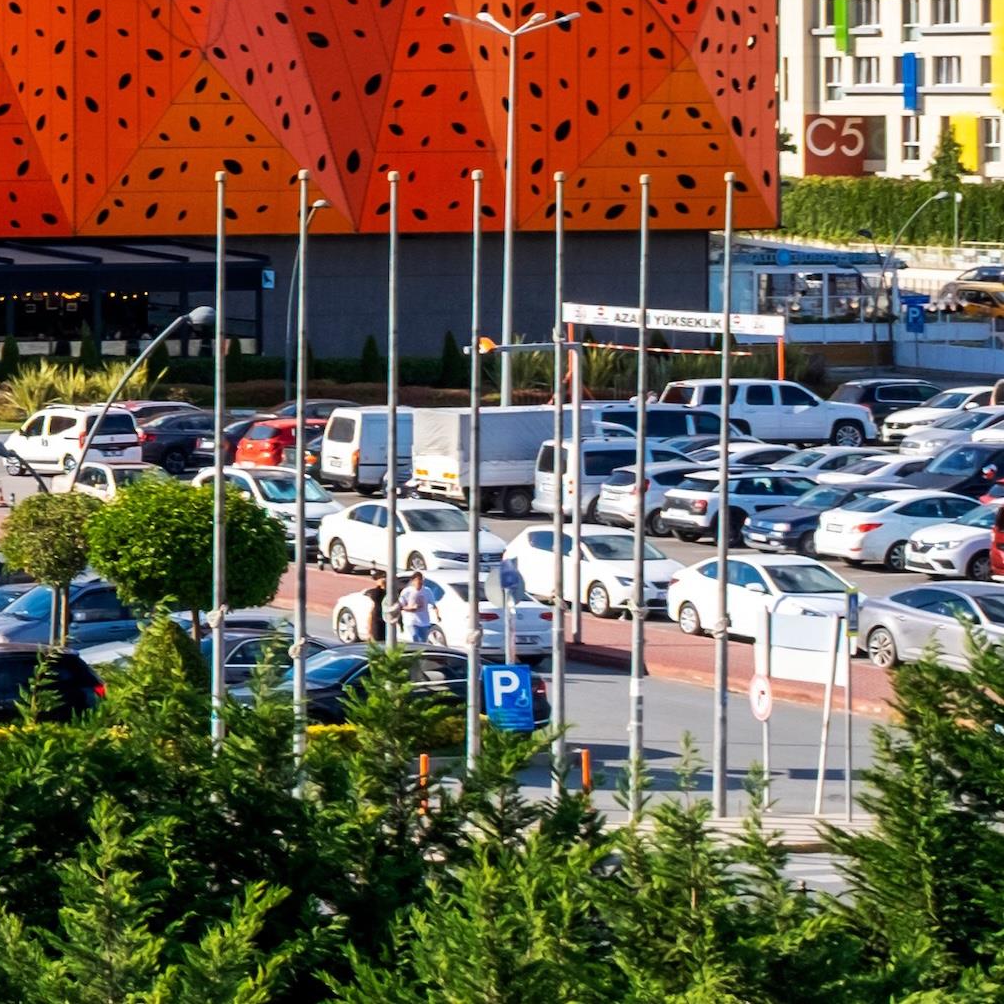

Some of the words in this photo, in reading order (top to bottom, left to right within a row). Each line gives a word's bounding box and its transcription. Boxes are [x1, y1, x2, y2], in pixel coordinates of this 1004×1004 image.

[806, 117, 864, 156] C5
[908, 307, 920, 323] P
[492, 670, 521, 707] P
